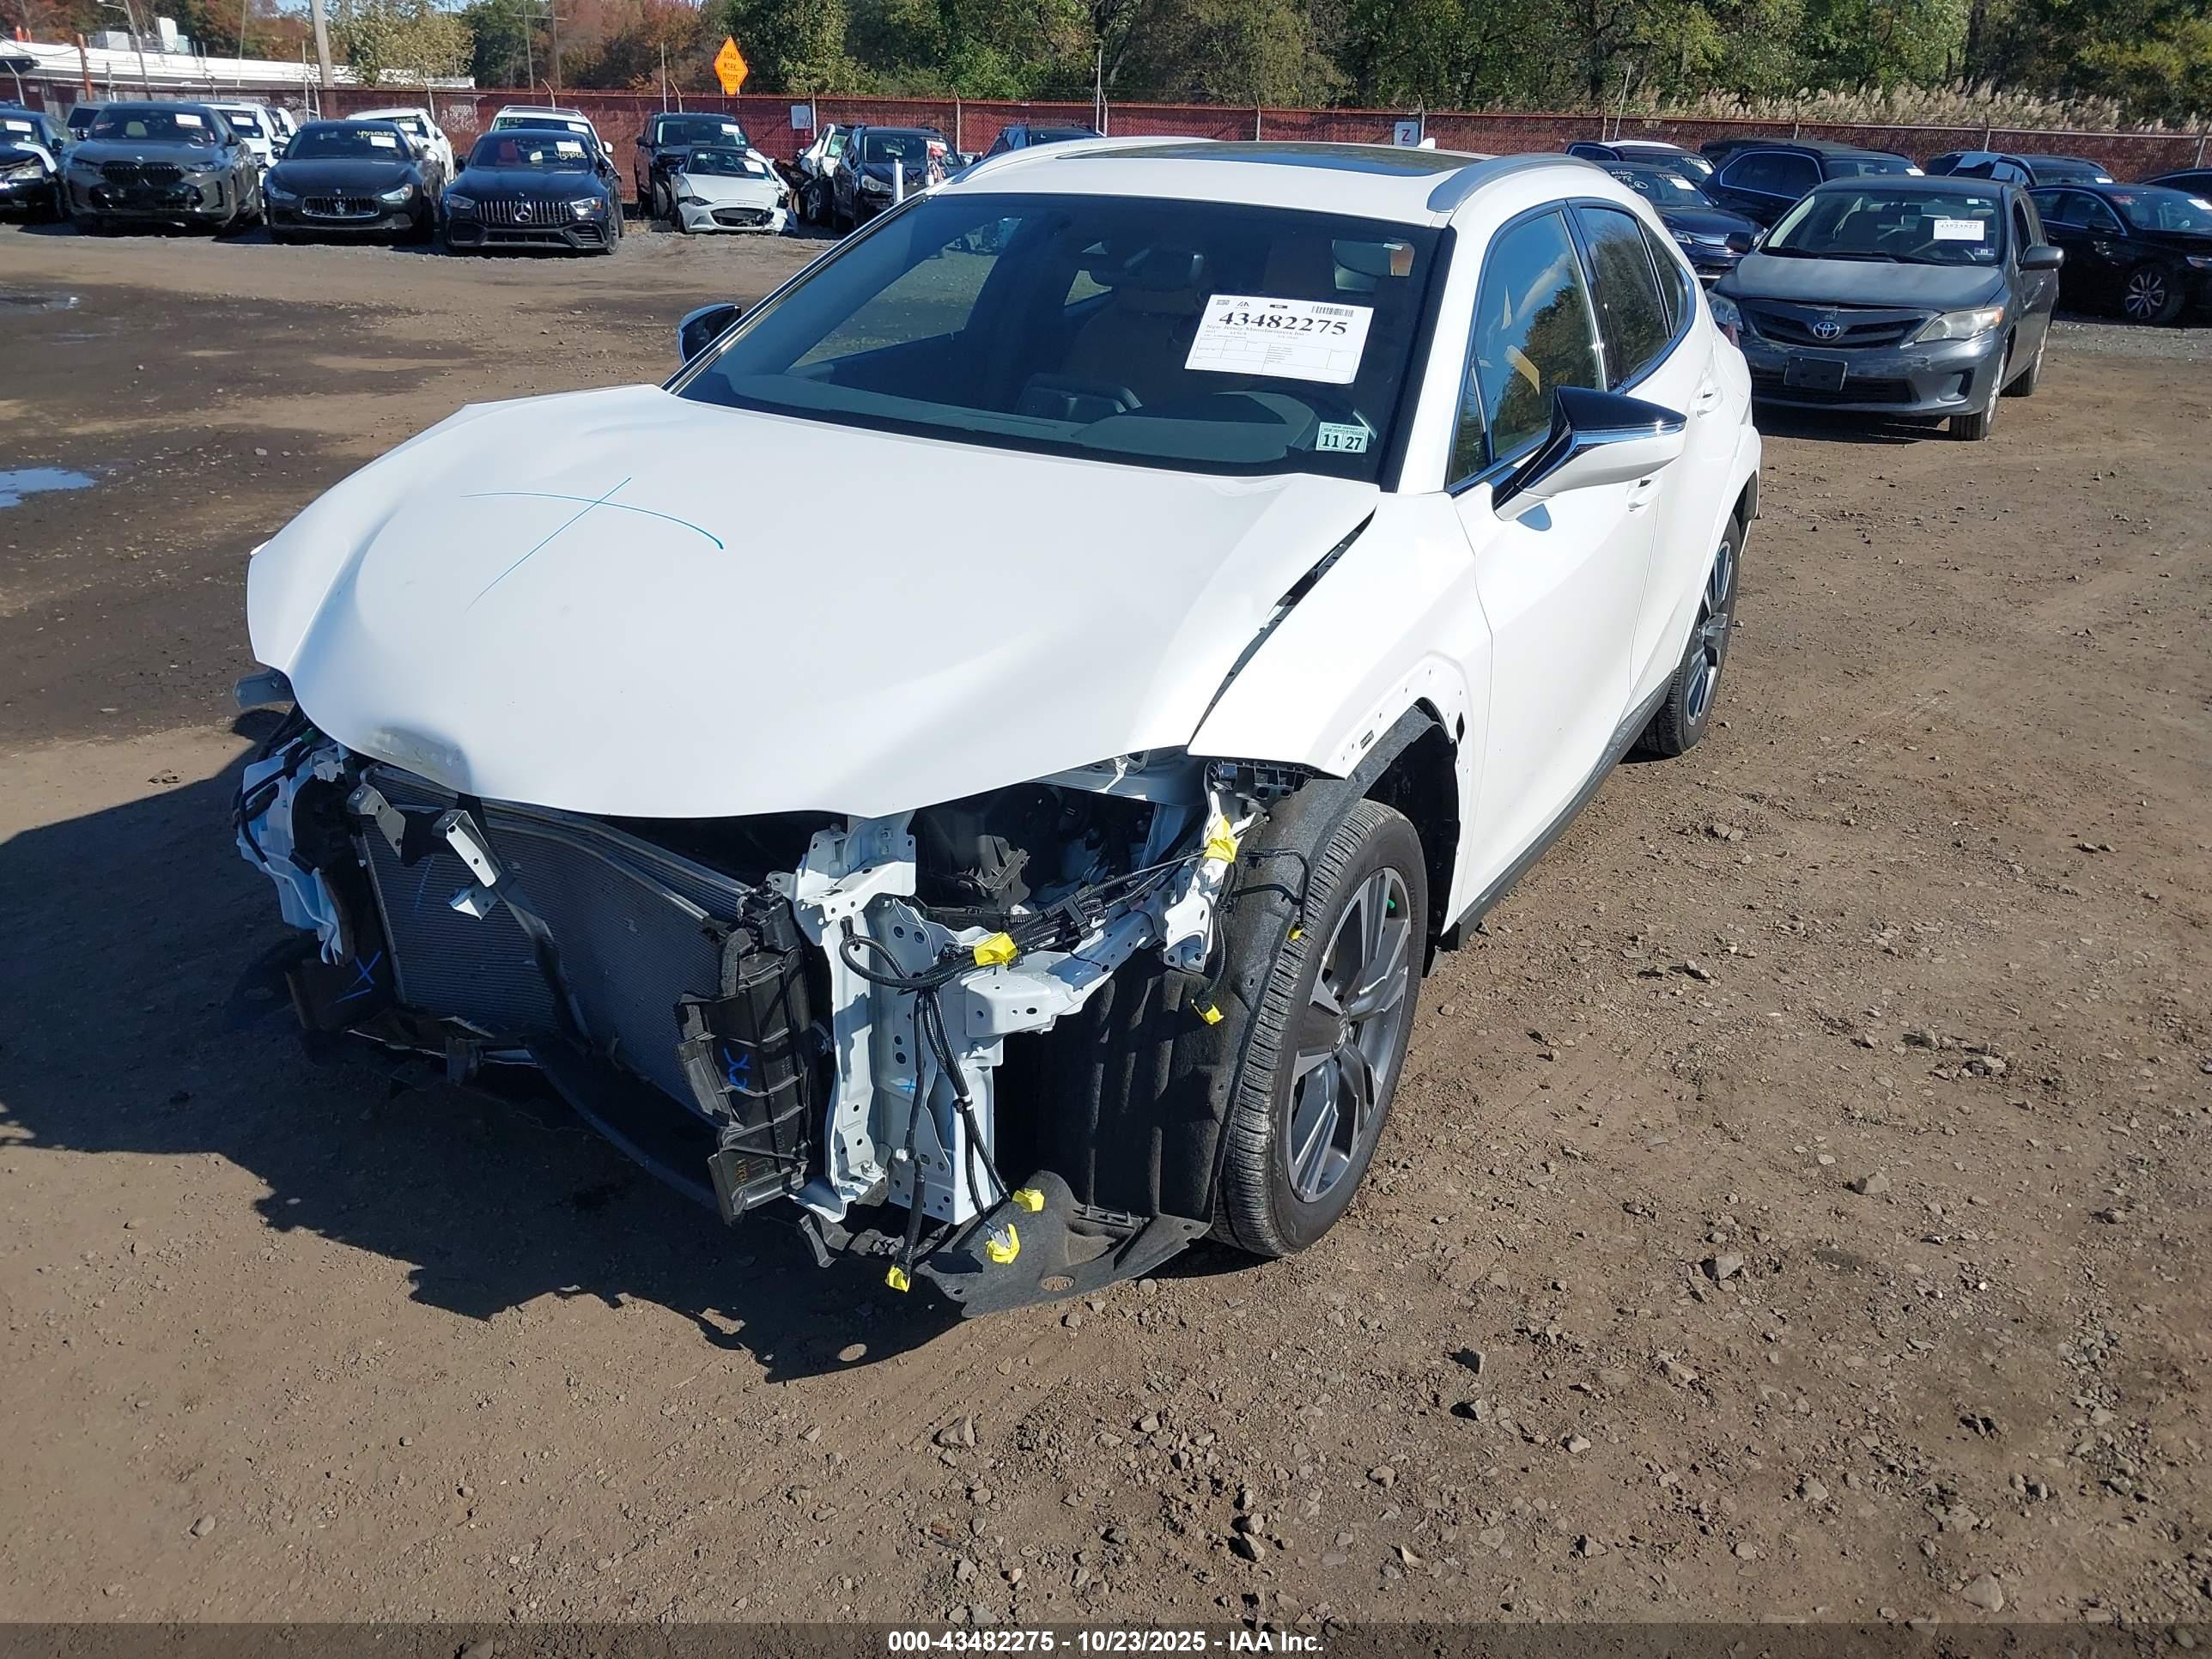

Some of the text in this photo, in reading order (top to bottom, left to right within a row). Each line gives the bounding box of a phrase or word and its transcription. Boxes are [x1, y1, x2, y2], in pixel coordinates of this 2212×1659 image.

[1401, 128, 1412, 142] Z
[1218, 311, 1348, 336] 43482275
[1322, 433, 1364, 451] 11 27
